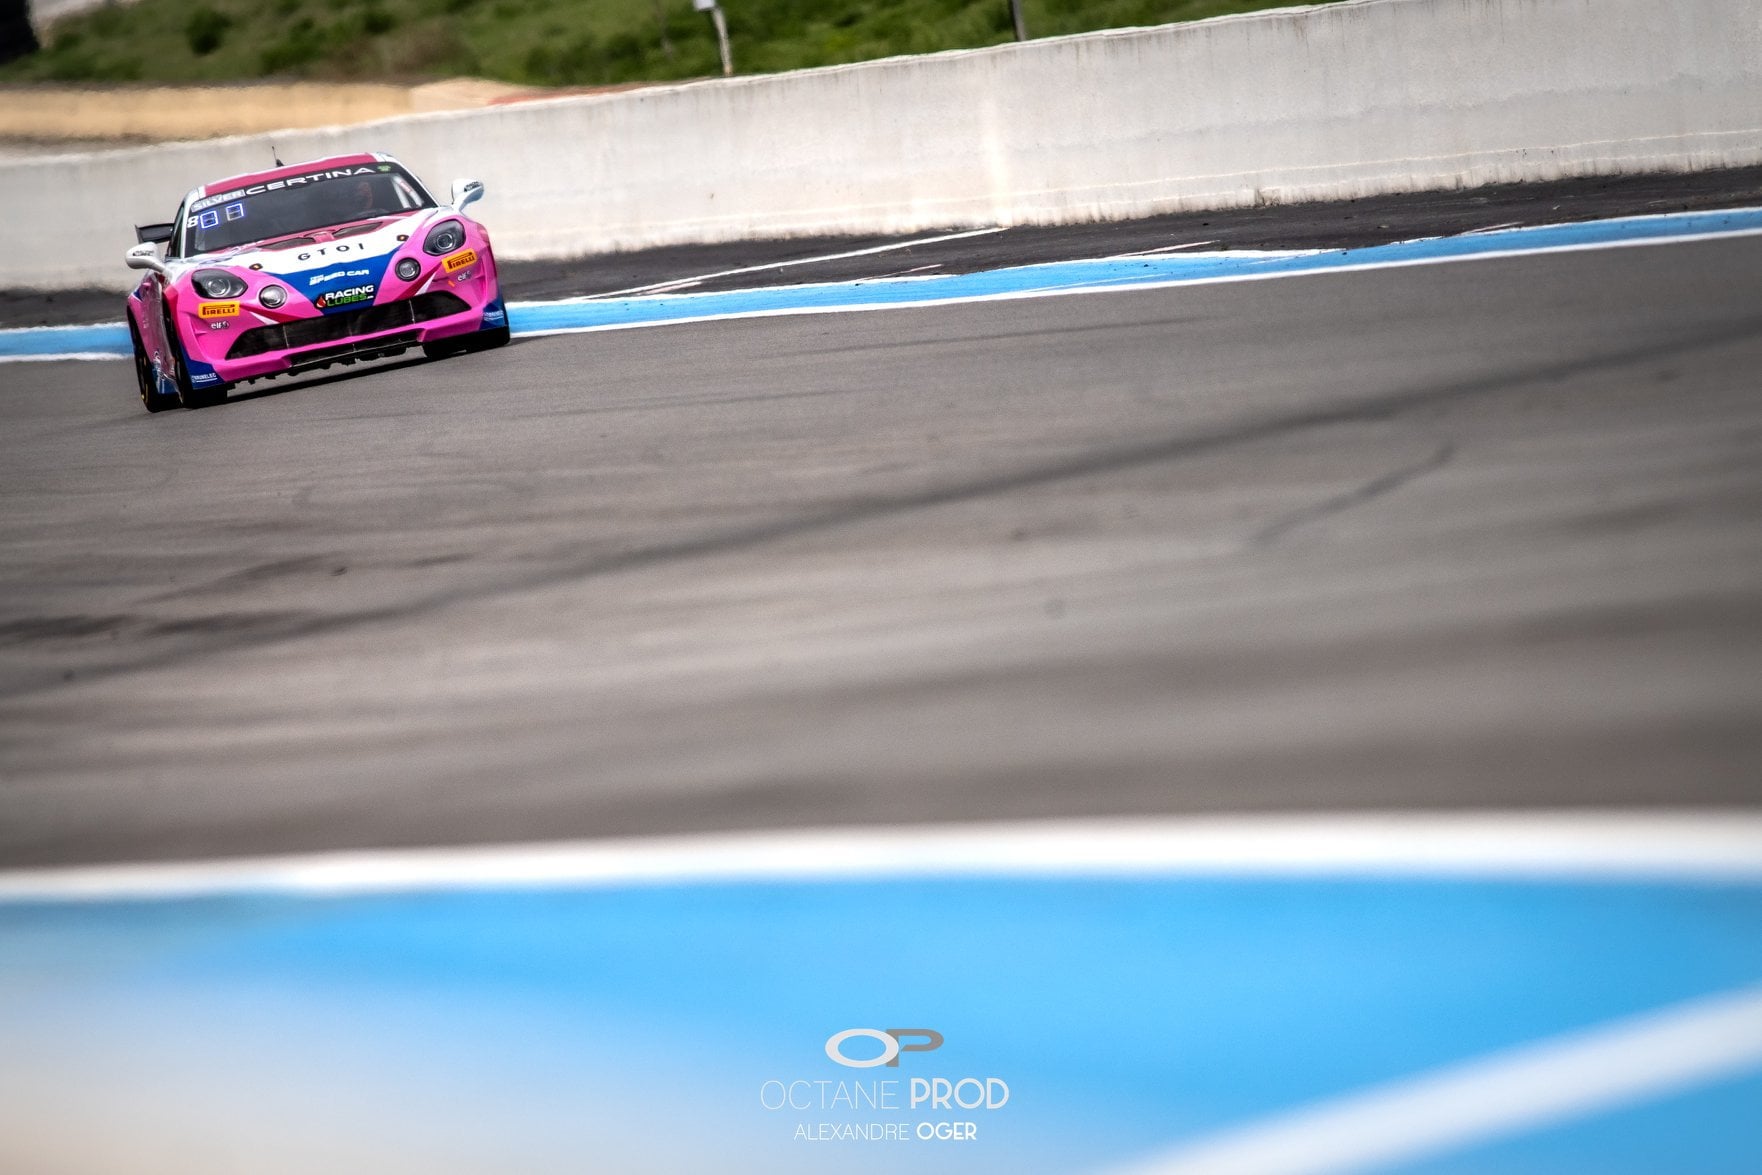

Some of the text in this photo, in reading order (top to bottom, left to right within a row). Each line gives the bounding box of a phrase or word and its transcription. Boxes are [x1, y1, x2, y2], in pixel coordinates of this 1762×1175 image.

[246, 167, 375, 196] CERTINA
[447, 251, 476, 270] PIRELLI
[325, 285, 374, 301] RACING
[327, 293, 368, 307] LUBES
[202, 304, 236, 316] PIRELLI
